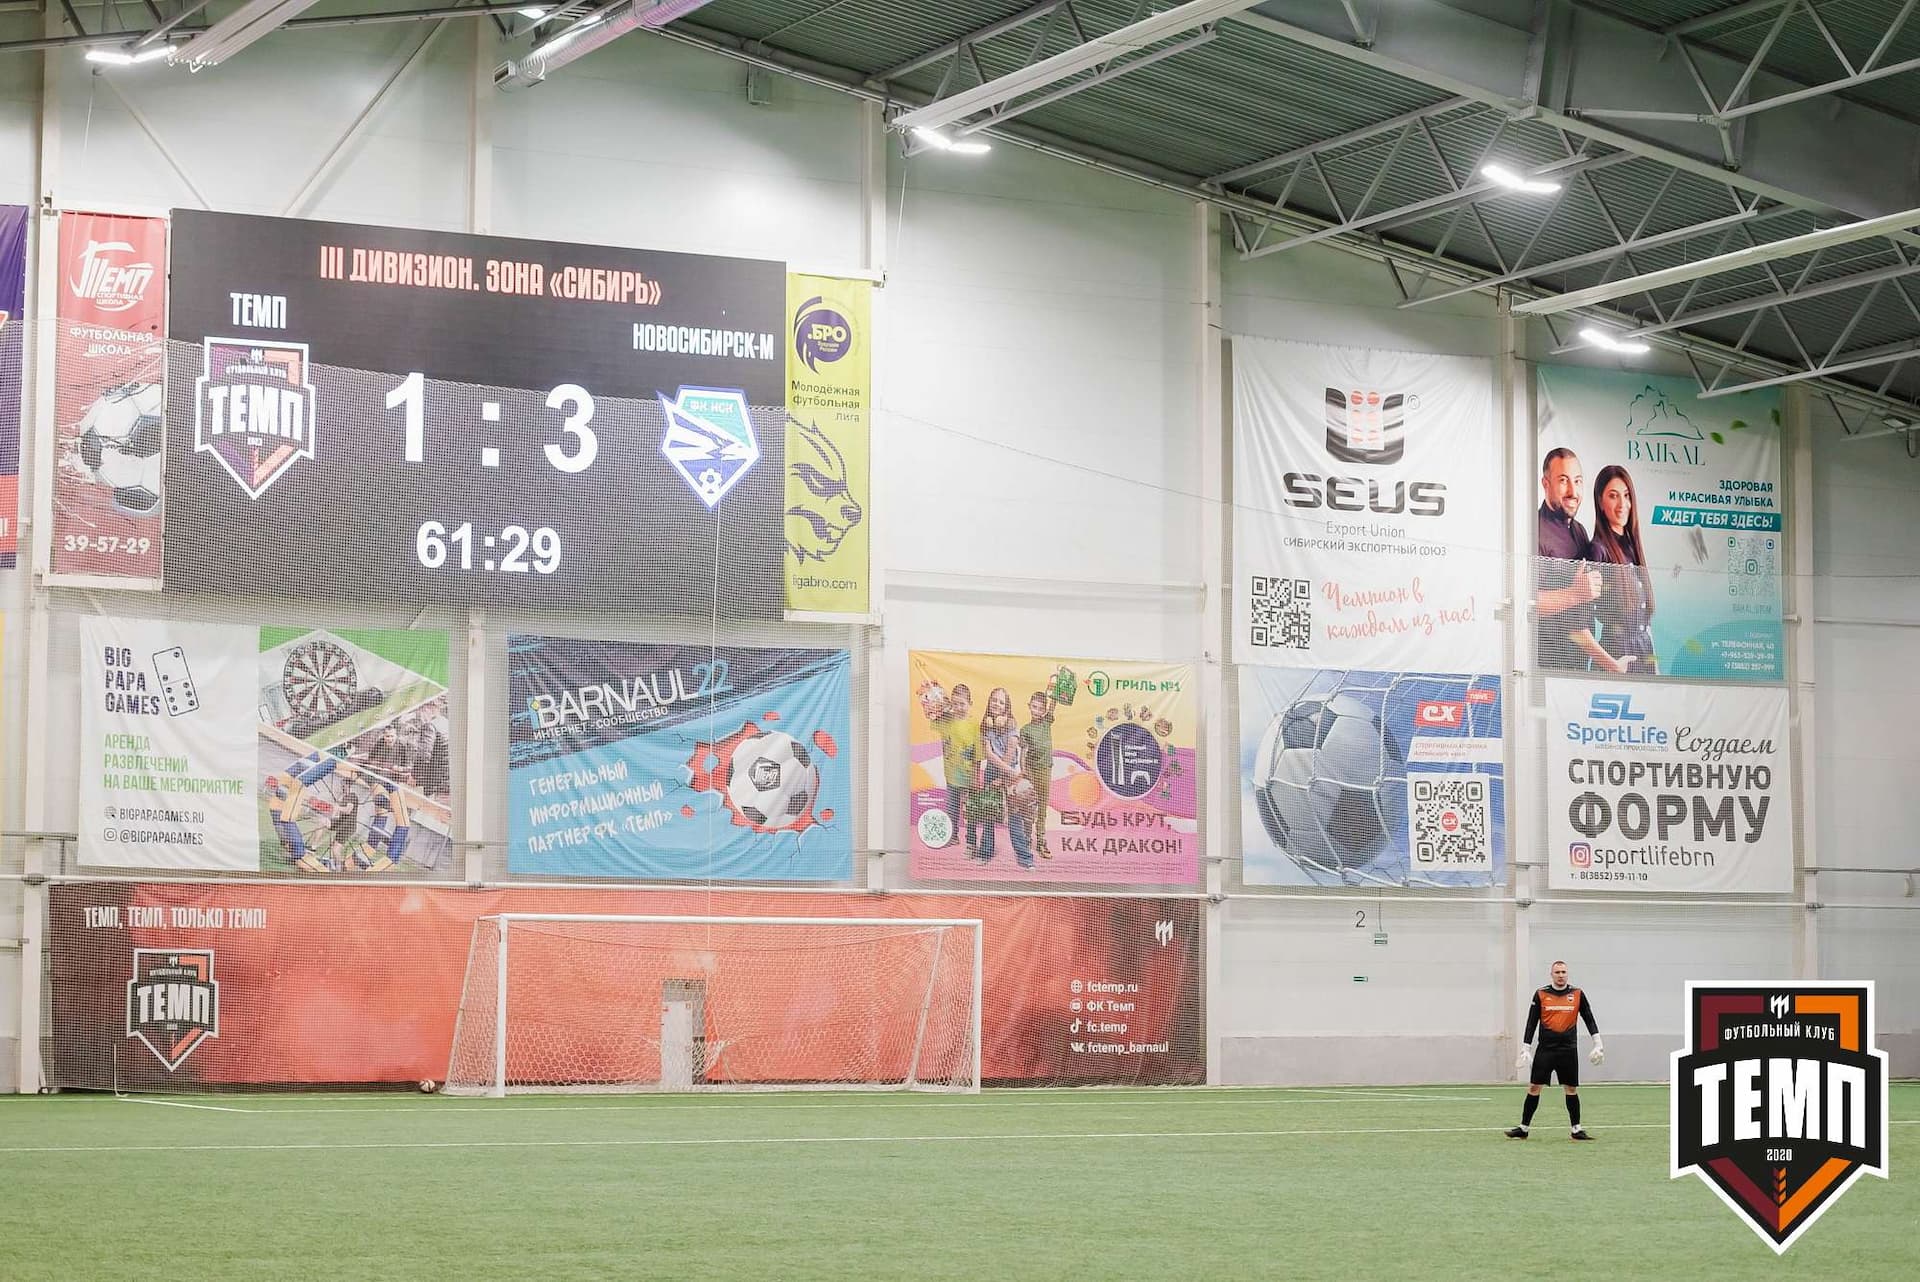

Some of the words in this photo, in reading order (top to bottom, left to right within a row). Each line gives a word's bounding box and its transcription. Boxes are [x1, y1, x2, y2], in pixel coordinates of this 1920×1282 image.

[69, 239, 154, 299] ТЕМП
[349, 248, 480, 291] ДИВИЗИОН.
[486, 259, 544, 296] ЗОНА
[549, 265, 662, 306] «СИБИРЬ»
[230, 292, 287, 329] ТЕМП
[70, 326, 154, 343] ФУТБОЛЬНАЯ
[632, 322, 775, 361] НОВОСИБИРСК-М
[87, 343, 132, 356] ШКОЛА
[791, 380, 860, 397] Молодёжная
[208, 384, 303, 442] ТЕМП
[385, 372, 425, 463] 1
[543, 383, 598, 473] 3
[1283, 472, 1447, 516] SEUS
[1719, 480, 1773, 493] ЗДОРОВАЯ
[1669, 491, 1676, 501] И
[1678, 491, 1731, 505] КРАСИВАЯ
[1734, 496, 1774, 508] УЛЫБКА
[1326, 520, 1367, 538] Export
[1370, 524, 1406, 538] Union
[1661, 509, 1696, 524] ЖДЕТ
[1700, 512, 1728, 526] ТЕБЯ
[1731, 514, 1773, 529] ЗДЕСЬ!
[64, 535, 150, 555] 39-57-29
[417, 520, 562, 575] 61:29
[1283, 536, 1345, 551] СИБИРСКИЙ
[1347, 540, 1417, 555] ЭКСПОРТНЫЙ
[1419, 545, 1447, 556] СОЮЗ
[1321, 581, 1408, 612] Чемпион
[1326, 609, 1408, 640] каждом
[1412, 613, 1434, 636] из
[1439, 595, 1476, 626] нас!
[104, 646, 132, 668] BIG
[105, 670, 147, 692] PAPA
[1116, 680, 1156, 691] ГРИЛЬ
[105, 692, 160, 716] GAMES
[1588, 693, 1646, 720] SL
[104, 734, 151, 752] АРЕНДА
[1567, 723, 1667, 744] SportLife
[1675, 726, 1776, 761] Создаем
[104, 754, 189, 773] РАЗВЛЕЧЕНИЙ
[1568, 758, 1771, 789] СПОРТИВНУЮ
[103, 774, 120, 789] НА
[123, 774, 157, 791] ВАШЕ
[160, 777, 244, 795] МЕРОПРИЯТИЕ
[529, 760, 628, 796] ГЕНЕРАЛЬНЫЙ
[529, 781, 664, 827] ИНФОРМАЦИОННЫЙ
[120, 808, 205, 824] BIGPAPAGAMES.RU
[1123, 812, 1171, 830] КРУТ,
[1568, 791, 1770, 843] ФОРМУ
[120, 829, 204, 846] @BIGPAPAGAMES
[528, 828, 591, 854] ПАРТНЕР
[594, 821, 618, 839] ФК
[1061, 837, 1097, 852] КАК
[1103, 838, 1183, 856] ДРАКОН!
[1594, 845, 1715, 869] sportlifebrn
[1580, 871, 1612, 881] 8(3852)
[1614, 872, 1647, 881] 59-11-10
[84, 906, 123, 929] ТЕМП,
[127, 907, 167, 929] ТЕМП,
[171, 907, 223, 929] ТОЛЬКО
[227, 908, 267, 929] ТЕМП!
[1355, 910, 1366, 928] 2
[1087, 981, 1138, 995] fctemp.ru
[137, 983, 210, 1024] ТЕМП
[1087, 1000, 1104, 1012] ФК
[1106, 1001, 1134, 1011] Темп
[1087, 1021, 1128, 1035] fc.temp
[1087, 1041, 1169, 1056] fctemp_barnaul
